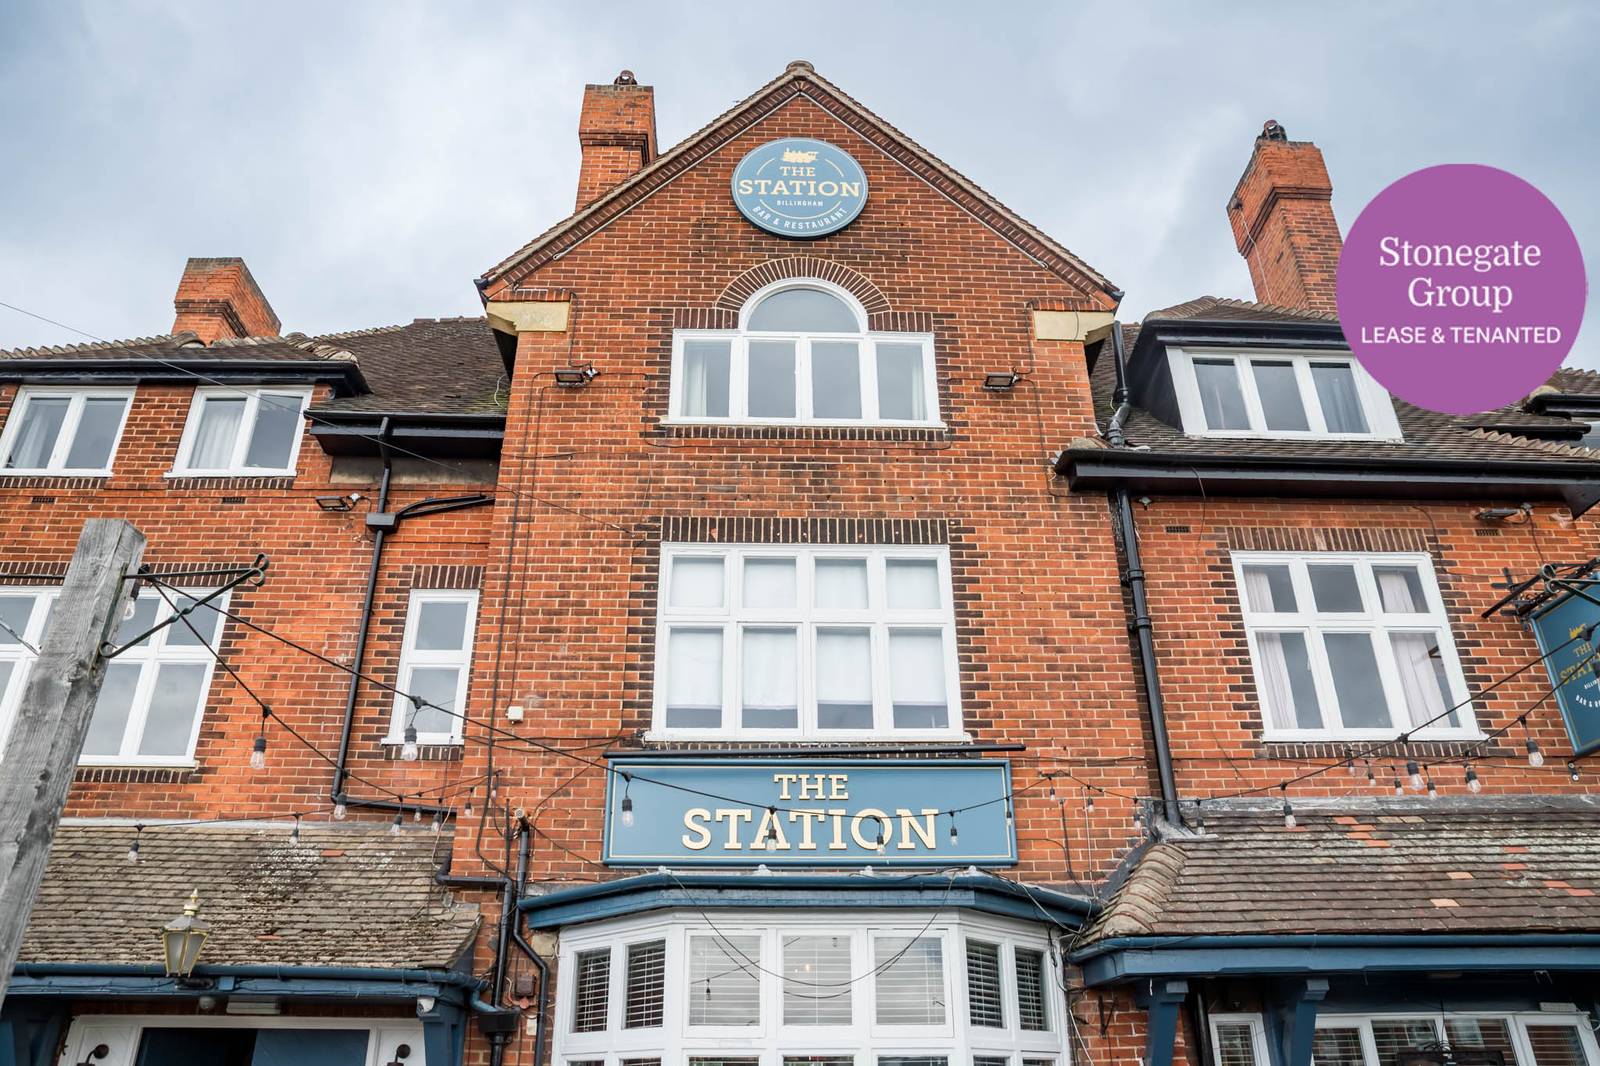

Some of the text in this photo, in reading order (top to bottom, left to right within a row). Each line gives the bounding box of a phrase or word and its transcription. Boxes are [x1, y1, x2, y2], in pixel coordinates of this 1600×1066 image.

[780, 166, 816, 177] THE
[738, 179, 861, 197] STATION
[752, 206, 771, 221] BAR
[784, 207, 848, 230] RESTAURANT
[773, 773, 849, 800] THE
[681, 807, 940, 851] STATION
